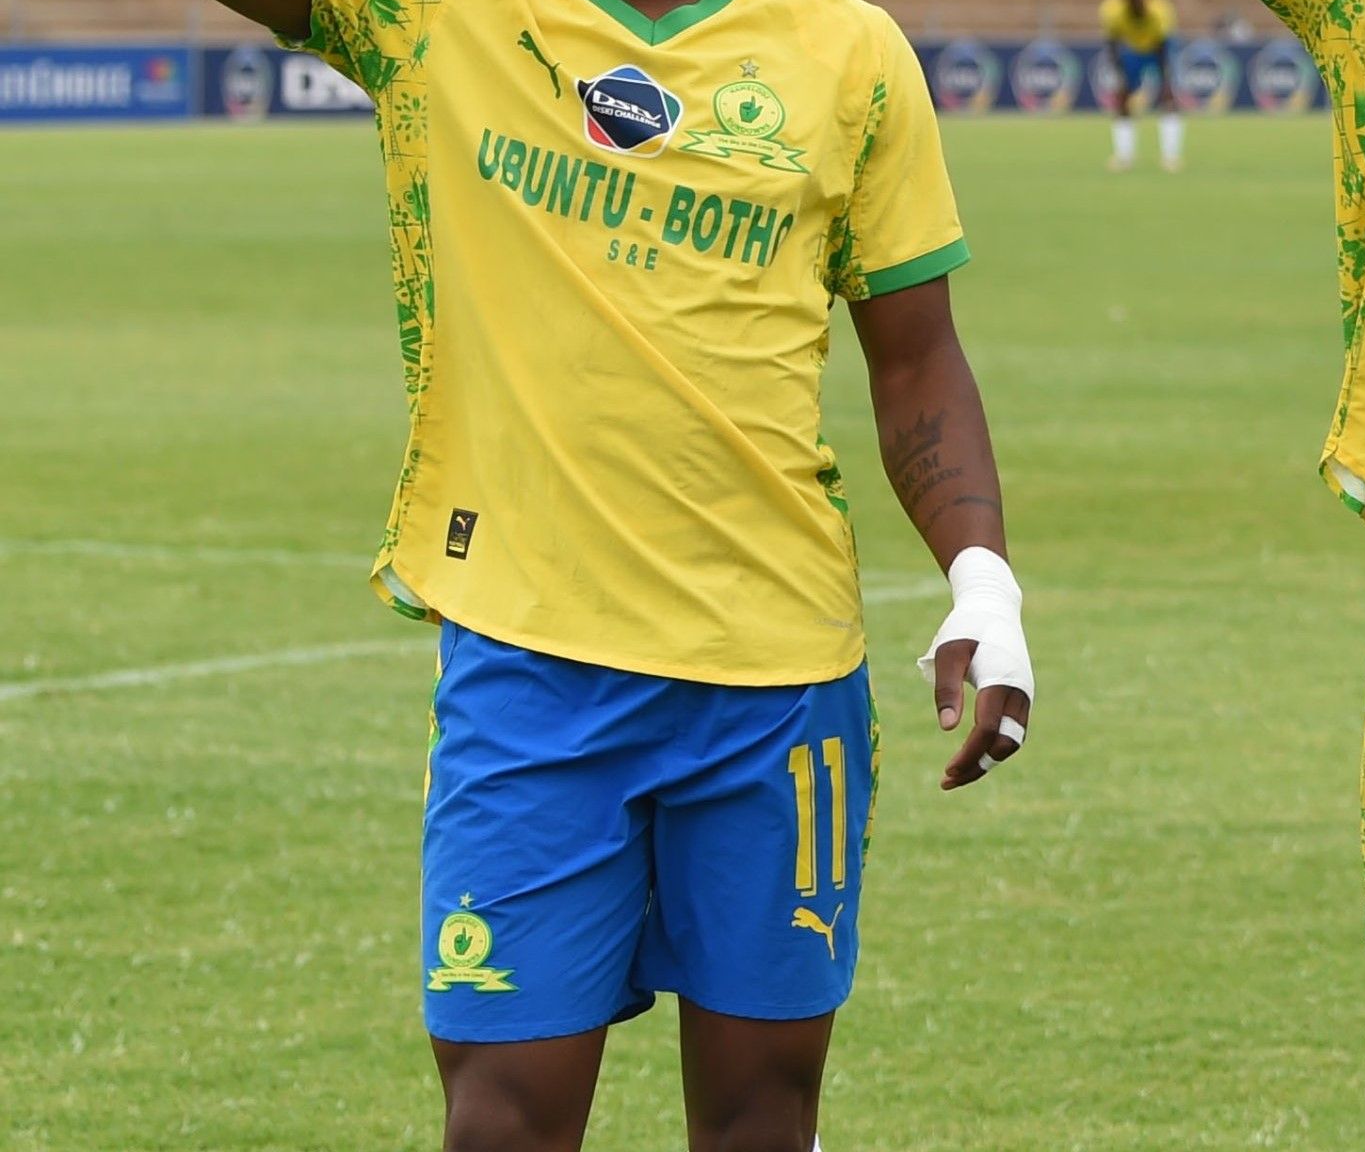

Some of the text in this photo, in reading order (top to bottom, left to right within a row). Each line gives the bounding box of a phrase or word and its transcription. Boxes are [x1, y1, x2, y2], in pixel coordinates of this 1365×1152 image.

[592, 89, 662, 121] DStv
[477, 128, 636, 229] UBUNTU
[607, 238, 659, 270] S & E
[787, 735, 847, 898] 11
